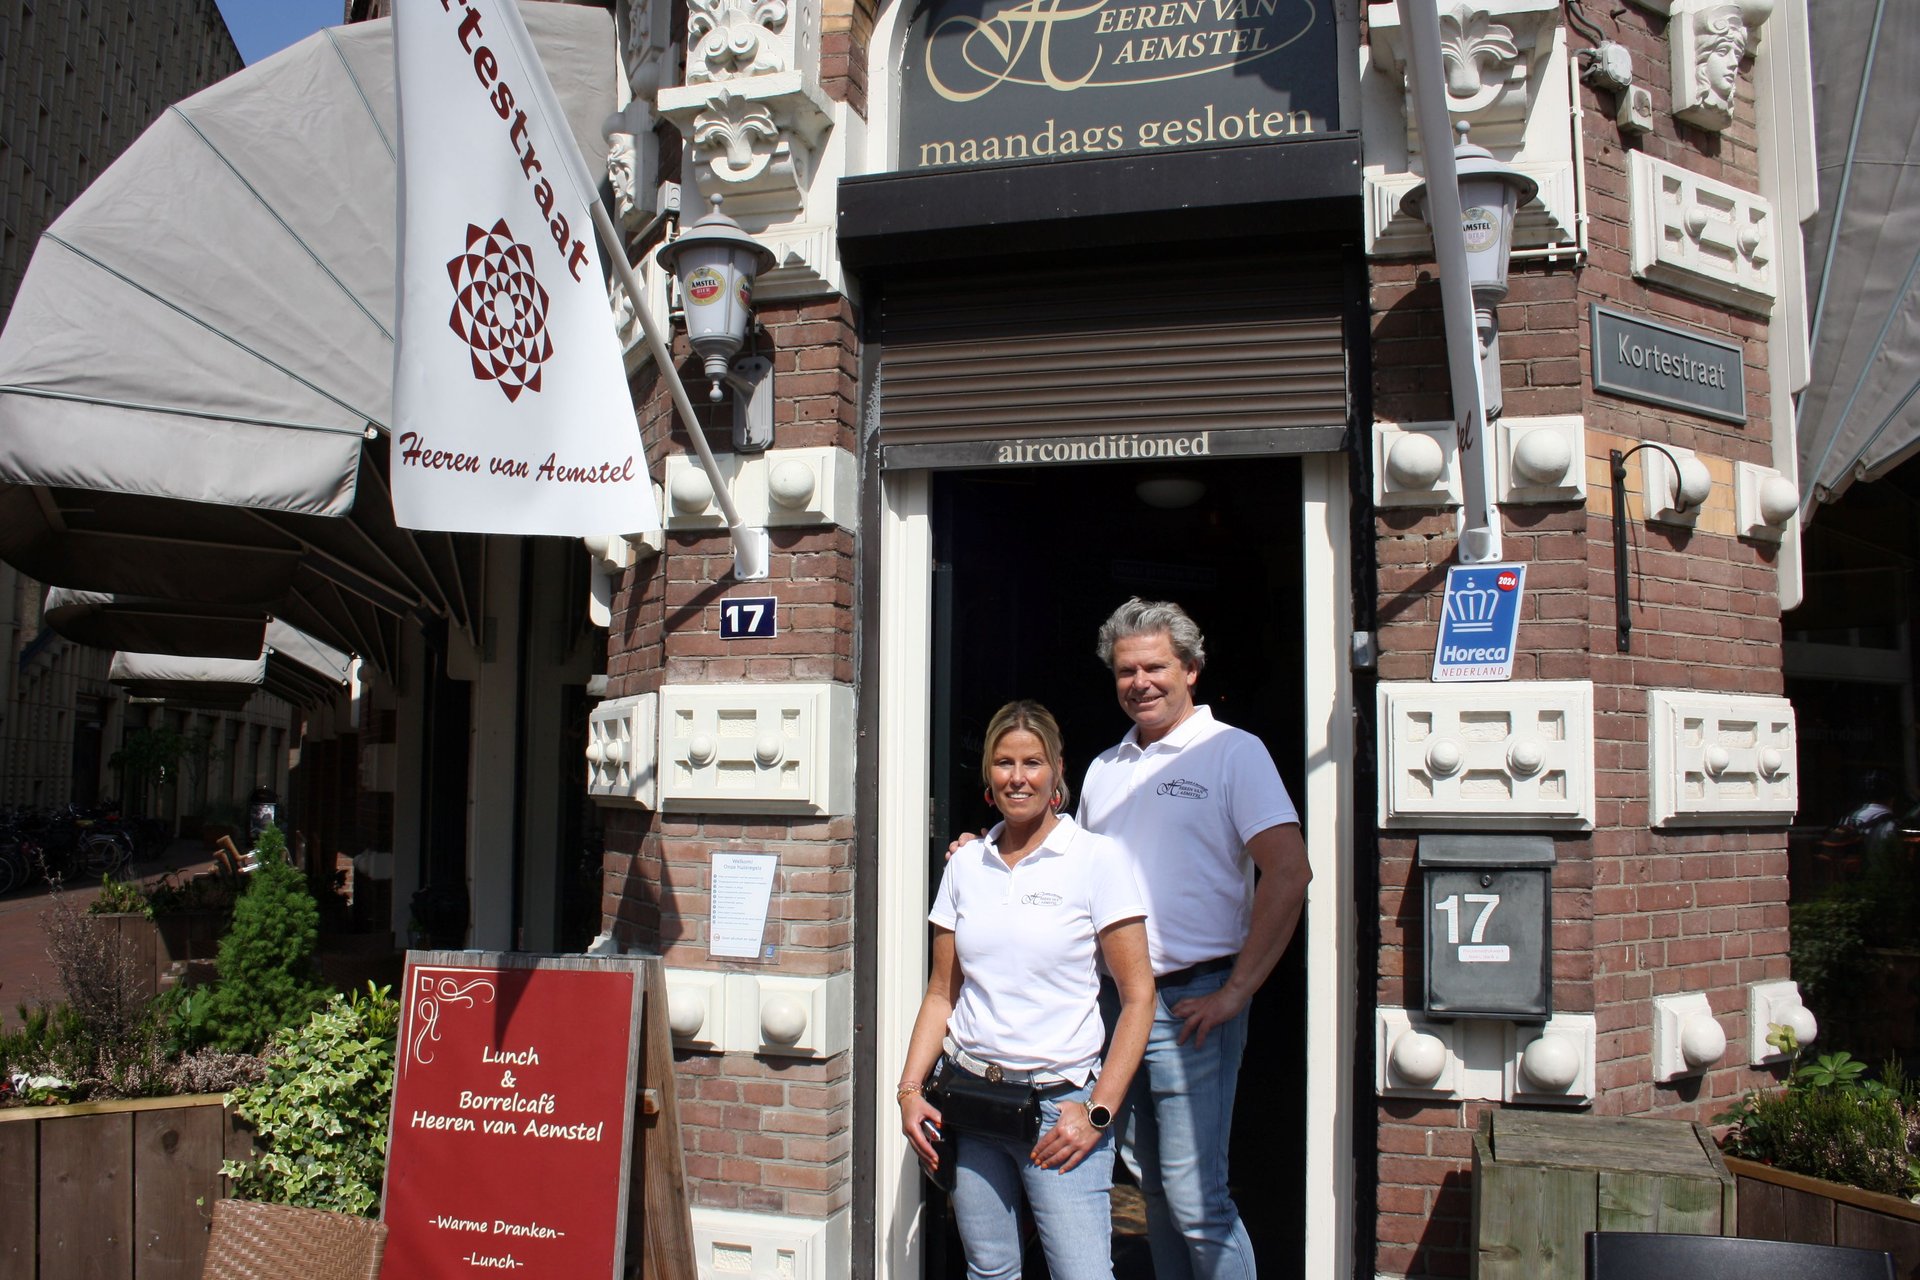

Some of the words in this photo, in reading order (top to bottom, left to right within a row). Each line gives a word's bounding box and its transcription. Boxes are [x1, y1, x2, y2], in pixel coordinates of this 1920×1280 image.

[1213, 0, 1278, 21] VAN
[1112, 27, 1269, 64] AEMSTEL
[918, 119, 1122, 167] maandags
[1138, 104, 1315, 147] gesloten
[1618, 332, 1726, 389] Kortestraat
[399, 432, 480, 473] Heeren
[490, 456, 529, 479] van
[536, 453, 635, 484] Aemstel
[999, 431, 1210, 463] airconditioned
[1498, 576, 1516, 586] 2024
[726, 605, 764, 632] 17
[1443, 646, 1506, 662] Horeca
[1442, 666, 1504, 677] NEDERLAND
[1436, 893, 1500, 944] 17
[483, 1046, 540, 1066] Lunch
[501, 1070, 517, 1088] &
[460, 1091, 555, 1114] Borrelcafé
[411, 1111, 475, 1131] Heeren
[483, 1119, 517, 1135] van
[523, 1119, 603, 1142] Aemstel
[429, 1215, 488, 1233] -Warme
[493, 1220, 565, 1239] Dranken-
[463, 1252, 524, 1269] -Lunch-
